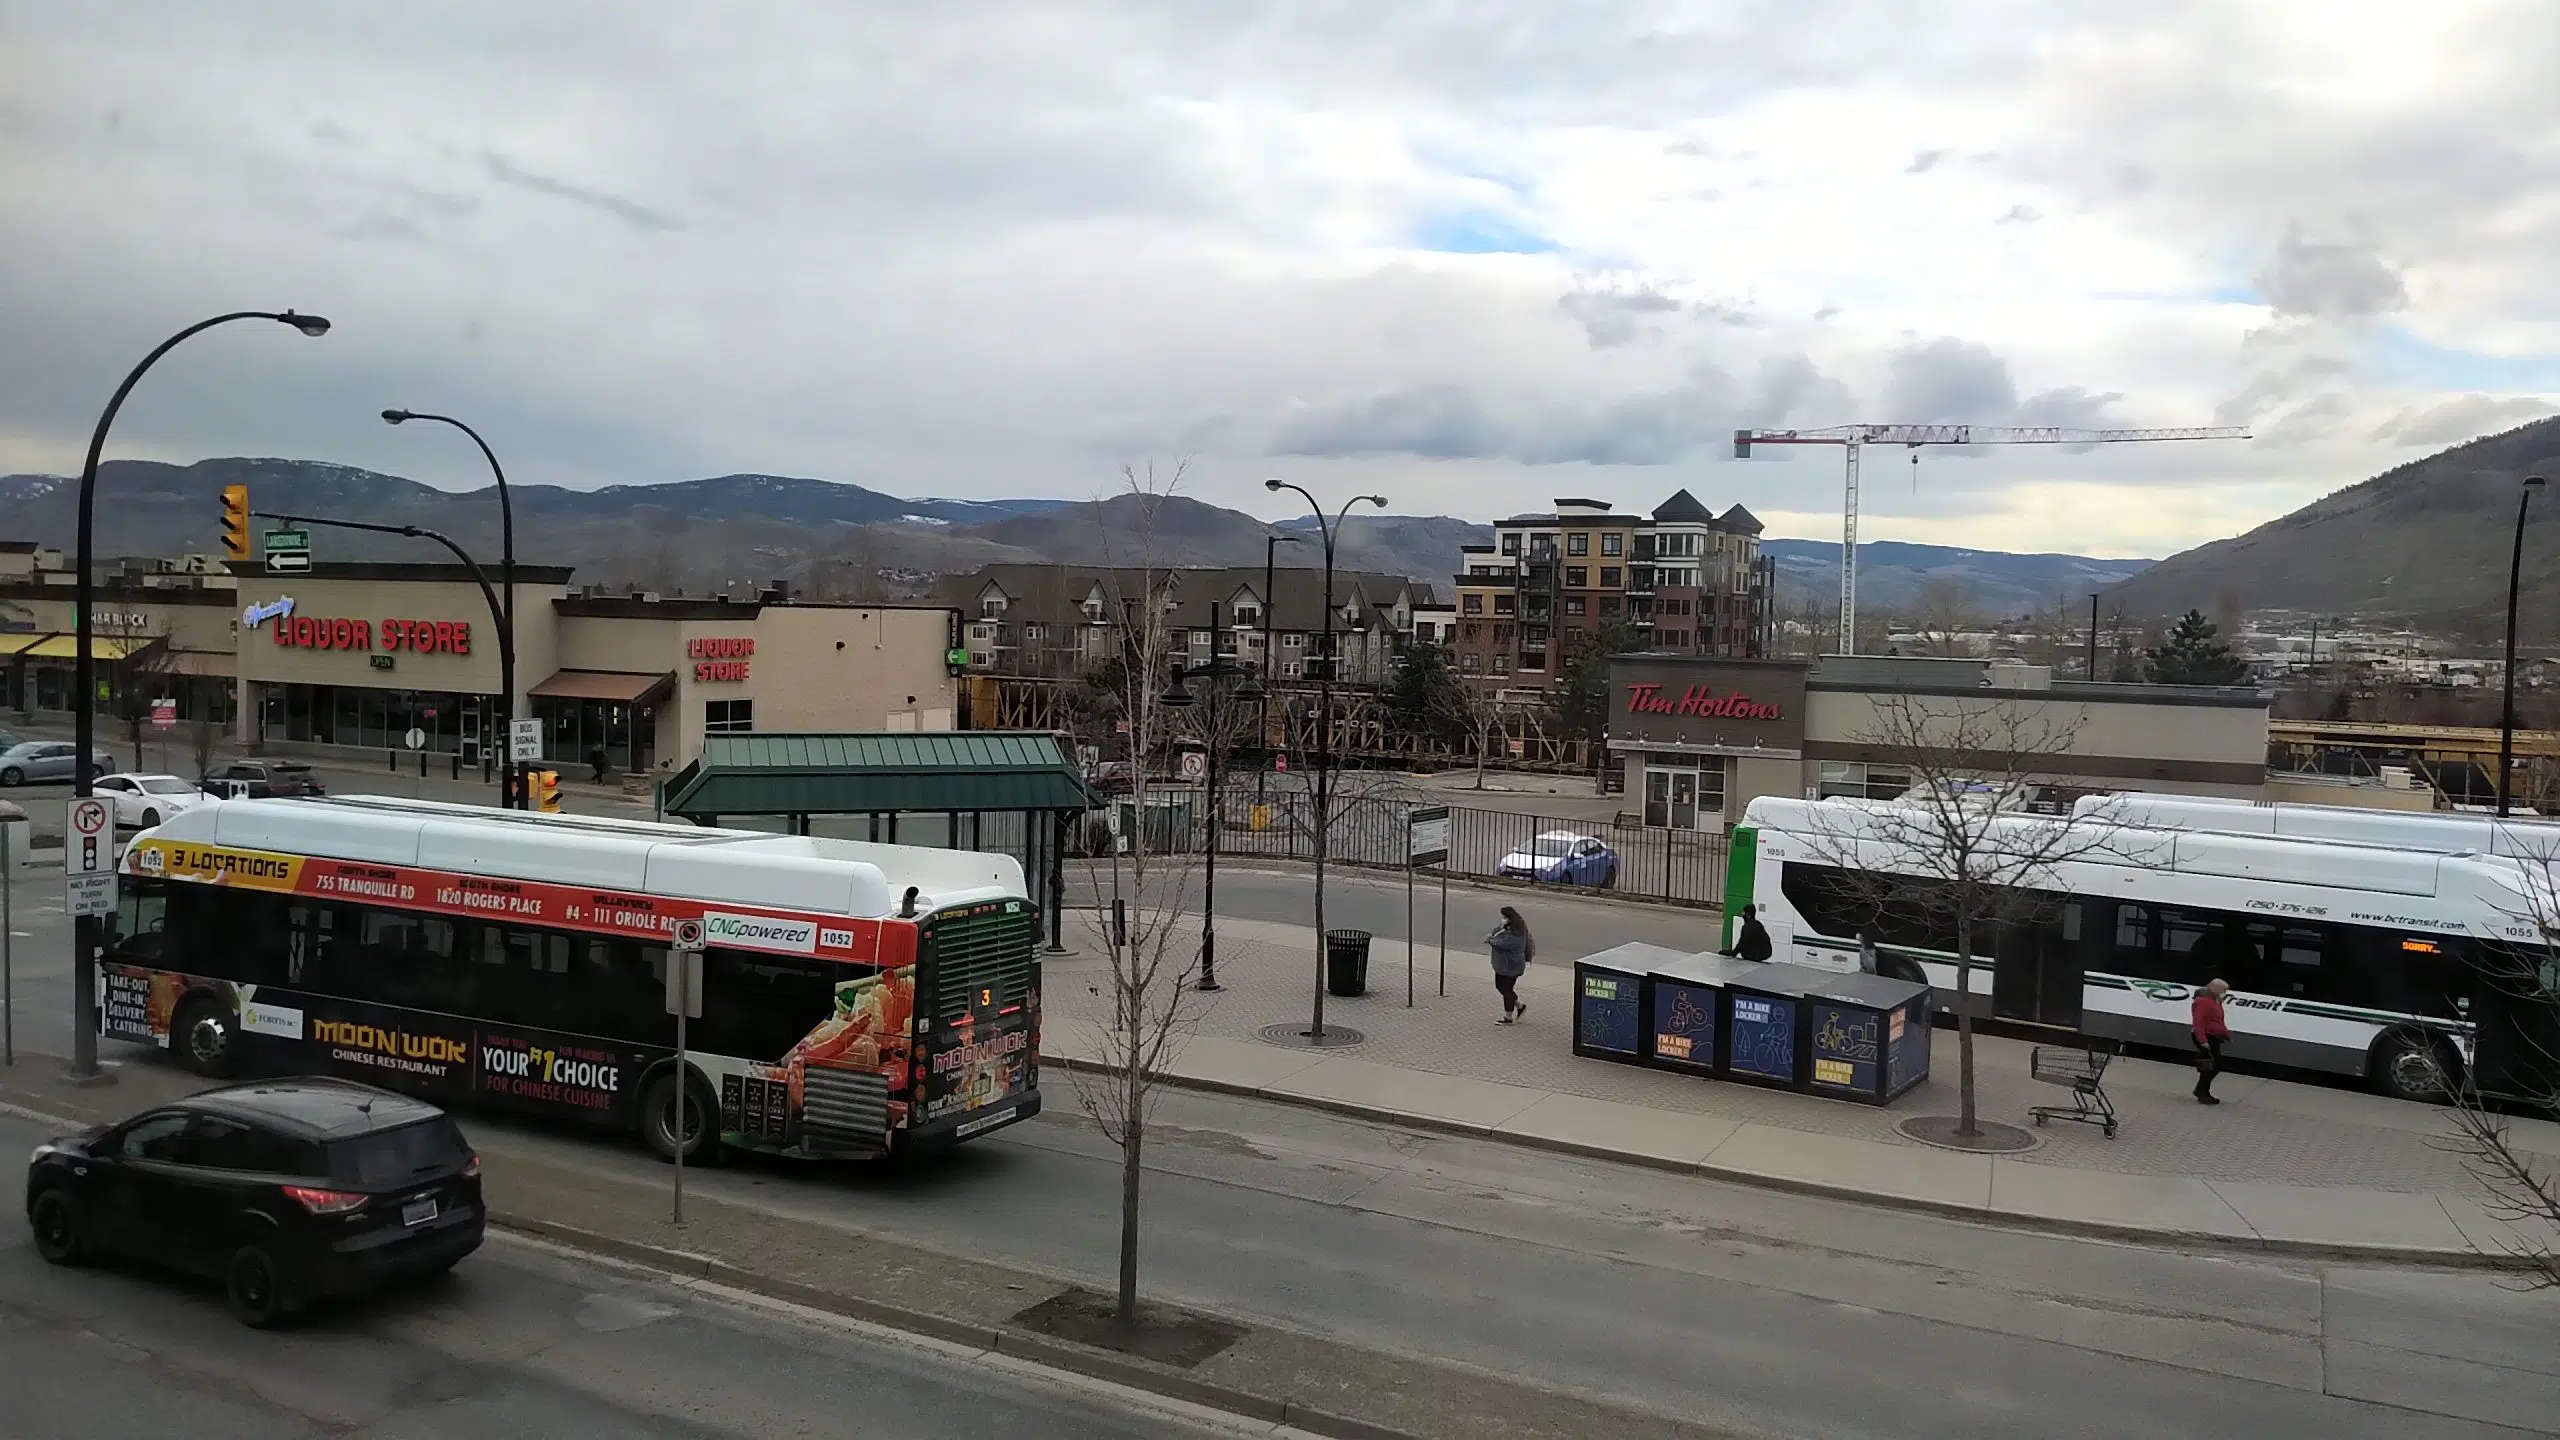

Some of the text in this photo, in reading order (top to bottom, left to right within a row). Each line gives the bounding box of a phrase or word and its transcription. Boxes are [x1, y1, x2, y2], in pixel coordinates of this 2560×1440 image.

[112, 613, 146, 627] BLOCK
[273, 615, 470, 655] LIQUOR STORE
[689, 638, 756, 658] LIQUOR
[696, 661, 750, 681] STORE
[1626, 683, 1781, 720] Tim Hortons
[519, 723, 533, 733] BUS
[515, 735, 537, 745] SIGNAL
[518, 747, 535, 756] ONLY
[143, 852, 162, 867] 1052
[1767, 848, 1785, 857] 1055
[172, 850, 290, 879] 3 LOCATIONS
[70, 879, 111, 889] NO RIGHT
[316, 874, 415, 901] 755 TRANQUILLE RD
[80, 889, 102, 899] TURN
[436, 888, 542, 915] 1820 ROGERS PLACE
[75, 900, 108, 911] ON RED
[565, 904, 580, 920] #4
[594, 907, 611, 924] 111
[615, 911, 657, 929] ORIOLE
[660, 915, 677, 931] RD
[2350, 911, 2466, 930] www.bctransit.com
[708, 917, 811, 943] CNGpowered
[823, 932, 851, 946] 1052
[2505, 927, 2533, 938] 1055
[109, 974, 150, 993] TAKE-OUT,
[1585, 987, 1609, 999] LOCKER
[1602, 980, 1618, 990] BIKE
[112, 989, 146, 1007] DINE-IN,
[981, 989, 991, 1006] 3
[108, 1002, 147, 1023] DELIVERY,
[1735, 1010, 1761, 1021] LOCKER
[105, 1018, 153, 1037] & CATERING
[313, 1018, 468, 1064] MOON WOK
[1657, 1043, 1683, 1057] LOCKER
[933, 1029, 1028, 1074] MOON WOK
[332, 1048, 448, 1077] CHINESE RESTAURANT
[482, 1046, 529, 1076] YOUR
[553, 1058, 619, 1092] CHOICE
[487, 1075, 611, 1110] FOR CHINESE CUISINE
